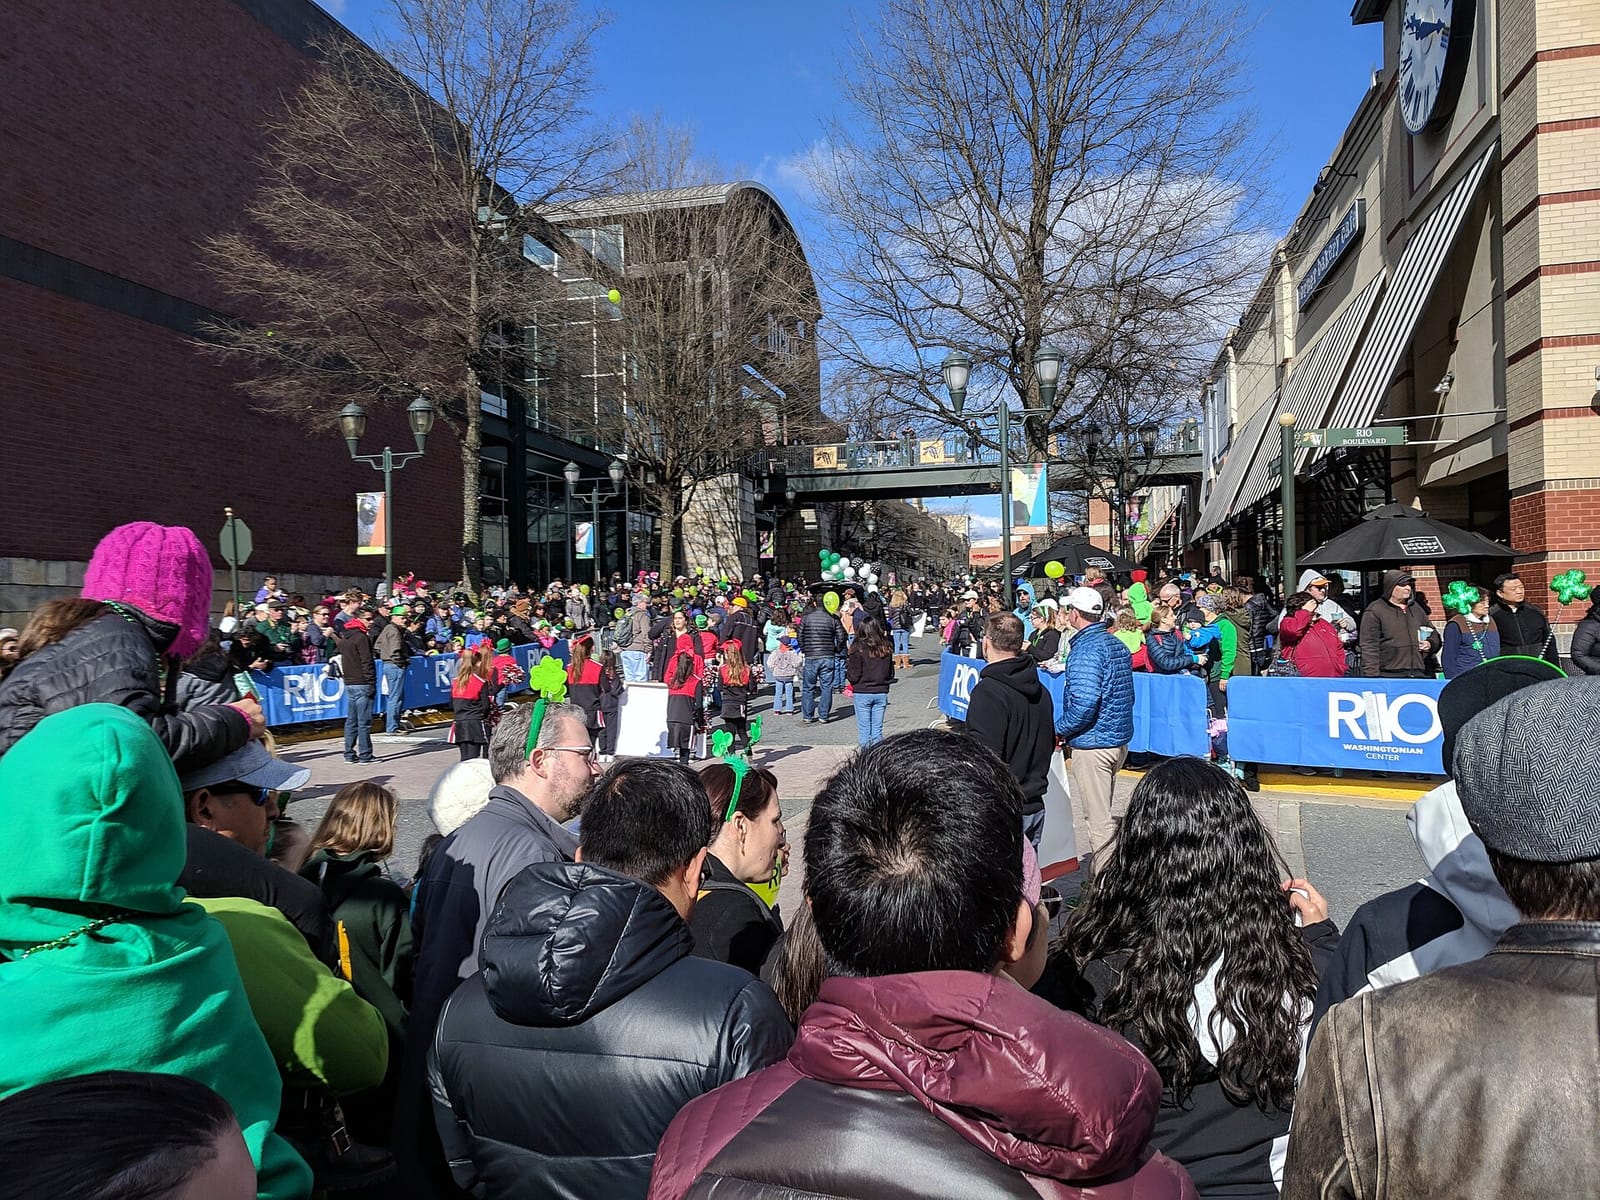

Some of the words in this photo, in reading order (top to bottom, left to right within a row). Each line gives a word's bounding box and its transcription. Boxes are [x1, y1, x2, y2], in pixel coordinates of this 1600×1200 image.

[1356, 429, 1373, 437] RIO
[1343, 437, 1387, 445] BOULEVARD
[284, 672, 344, 705] RIO
[1328, 691, 1443, 744] RIO
[1342, 743, 1423, 754] WASHINGTONIAN
[1366, 752, 1400, 761] CENTER
